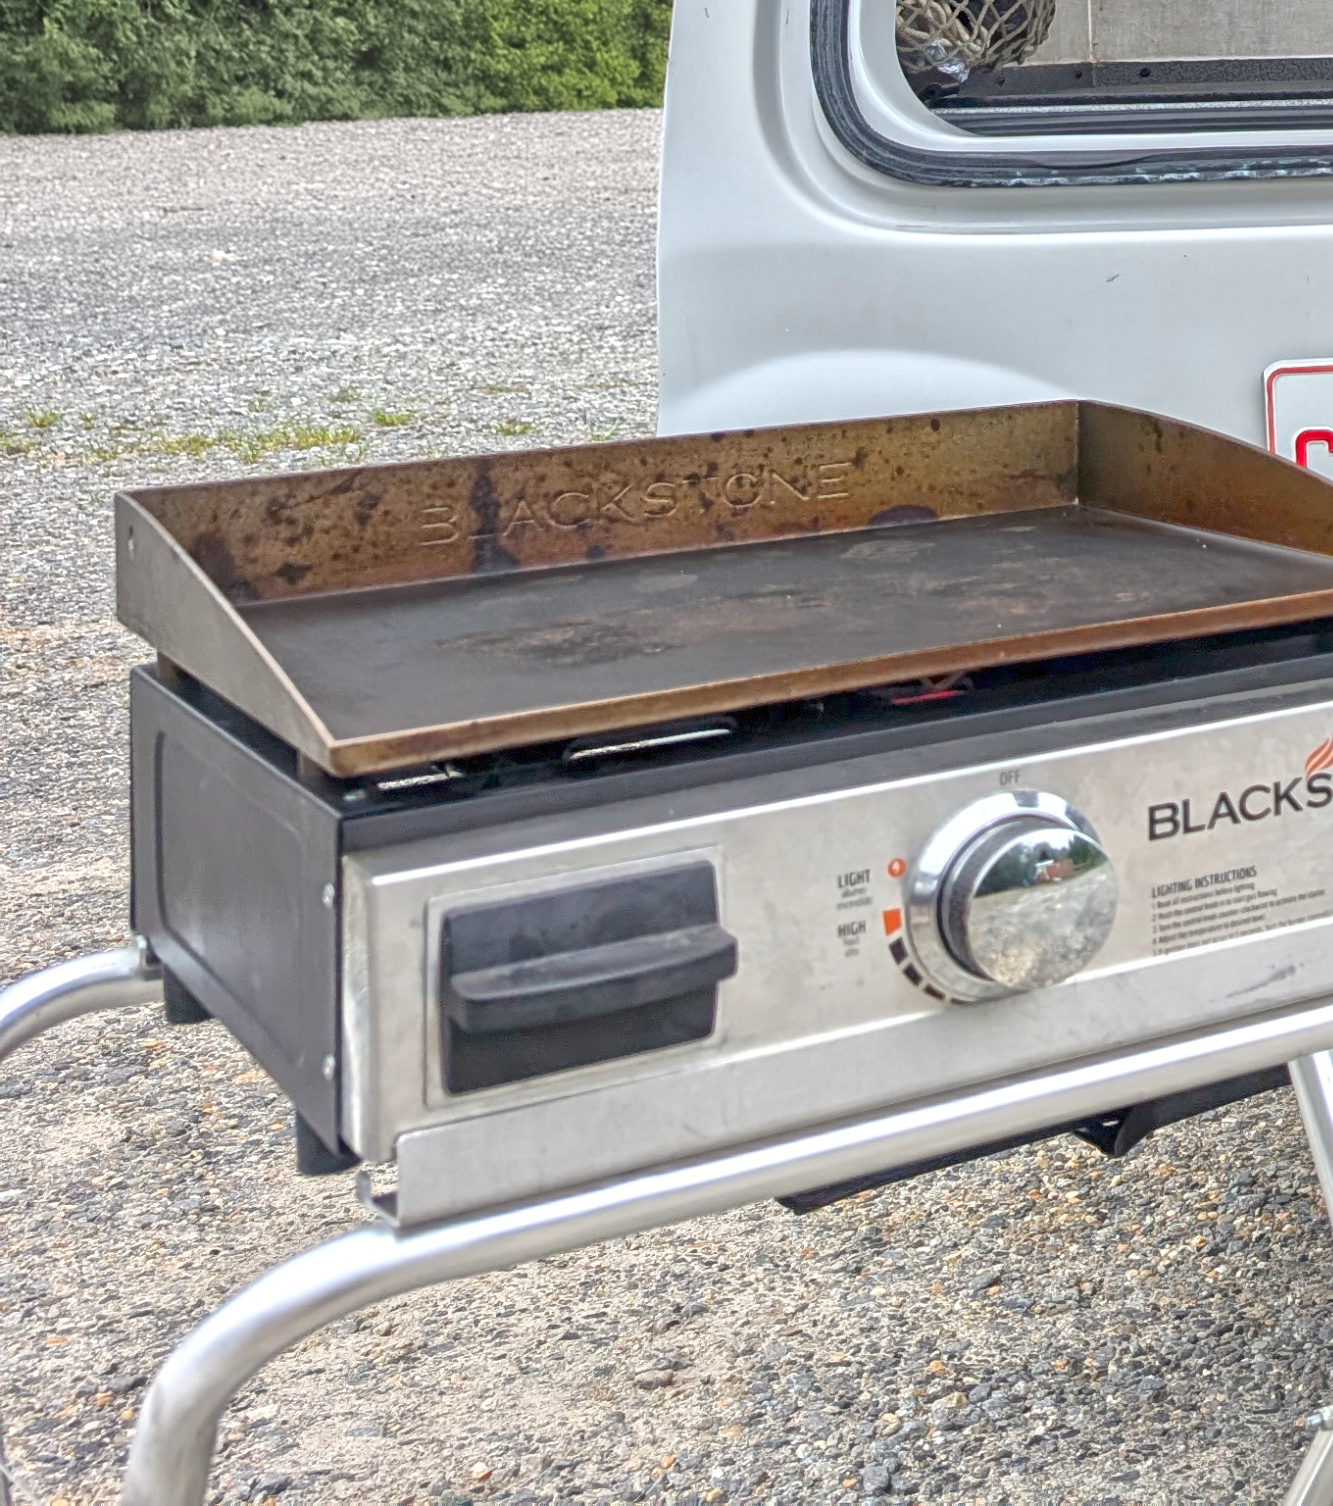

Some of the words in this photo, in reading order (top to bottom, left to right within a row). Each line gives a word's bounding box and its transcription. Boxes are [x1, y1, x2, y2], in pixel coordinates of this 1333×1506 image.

[418, 462, 852, 546] BLACKSTONE
[999, 769, 1021, 786] OFF
[838, 869, 871, 888] LIGHT
[1152, 879, 1193, 899] LIGHTING
[1194, 865, 1258, 889] INSTRUCTIONS
[838, 920, 867, 937] HIGH
